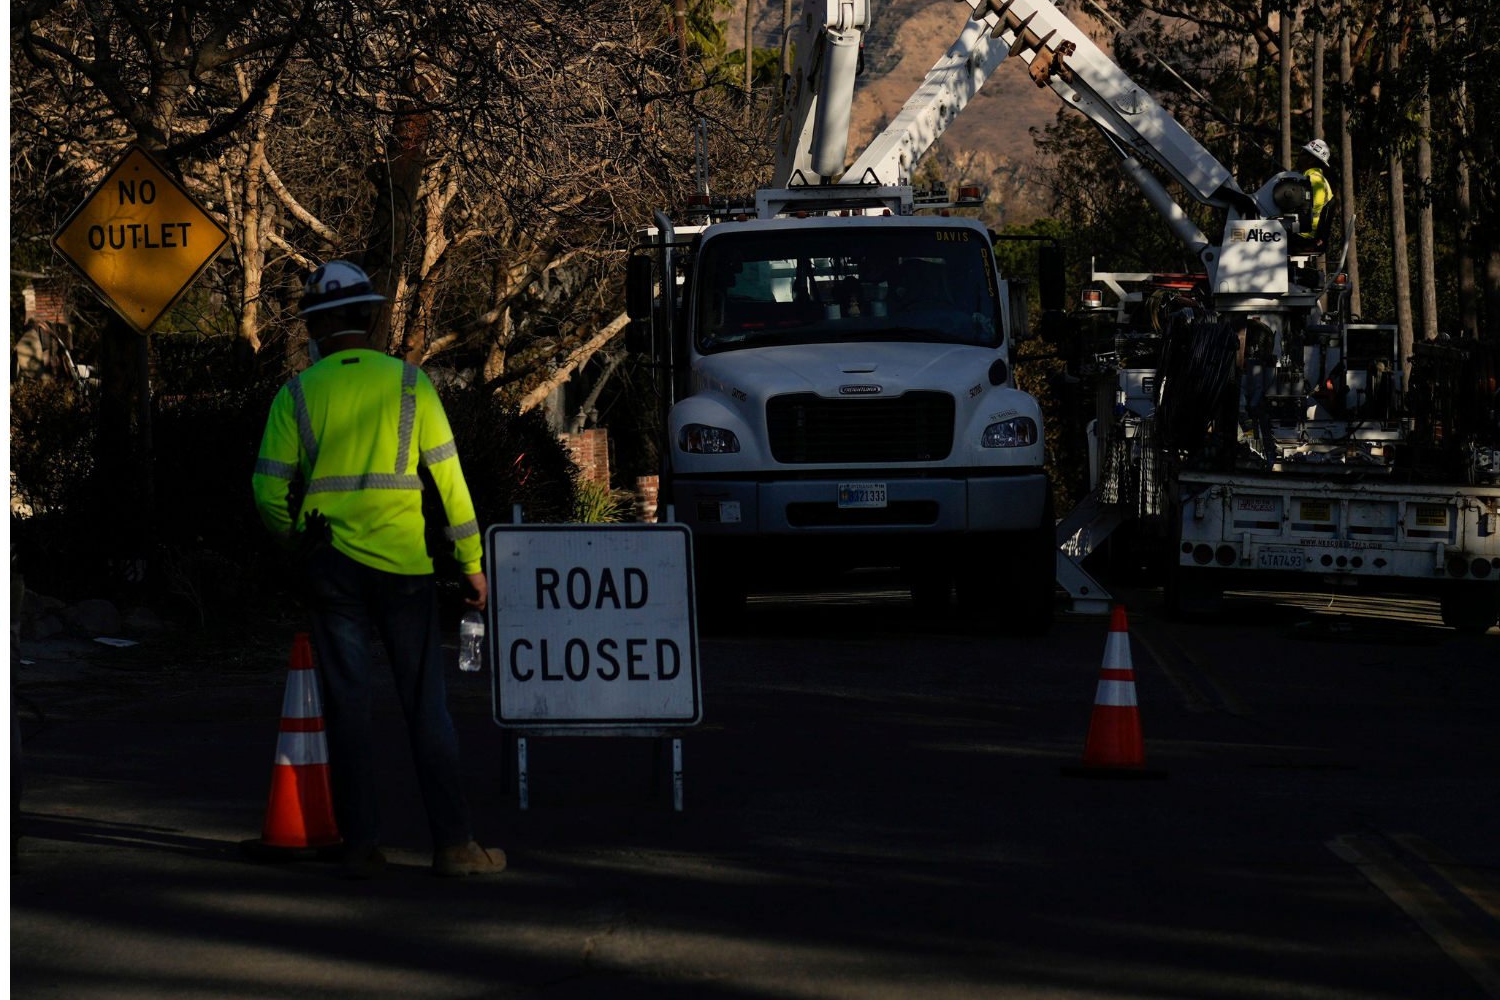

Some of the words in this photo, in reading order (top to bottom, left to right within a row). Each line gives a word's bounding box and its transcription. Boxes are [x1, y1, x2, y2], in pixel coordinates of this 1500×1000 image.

[118, 179, 156, 205] NO
[88, 223, 191, 251] OUTLET
[935, 230, 970, 242] DAVIS
[1246, 228, 1282, 242] Altec
[980, 247, 995, 298] DAVIS
[849, 490, 886, 502] 3321333
[1418, 509, 1445, 517] CAUTION
[1260, 554, 1302, 567] 4TA7493
[535, 567, 649, 611] ROAD
[509, 637, 681, 682] CLOSED
